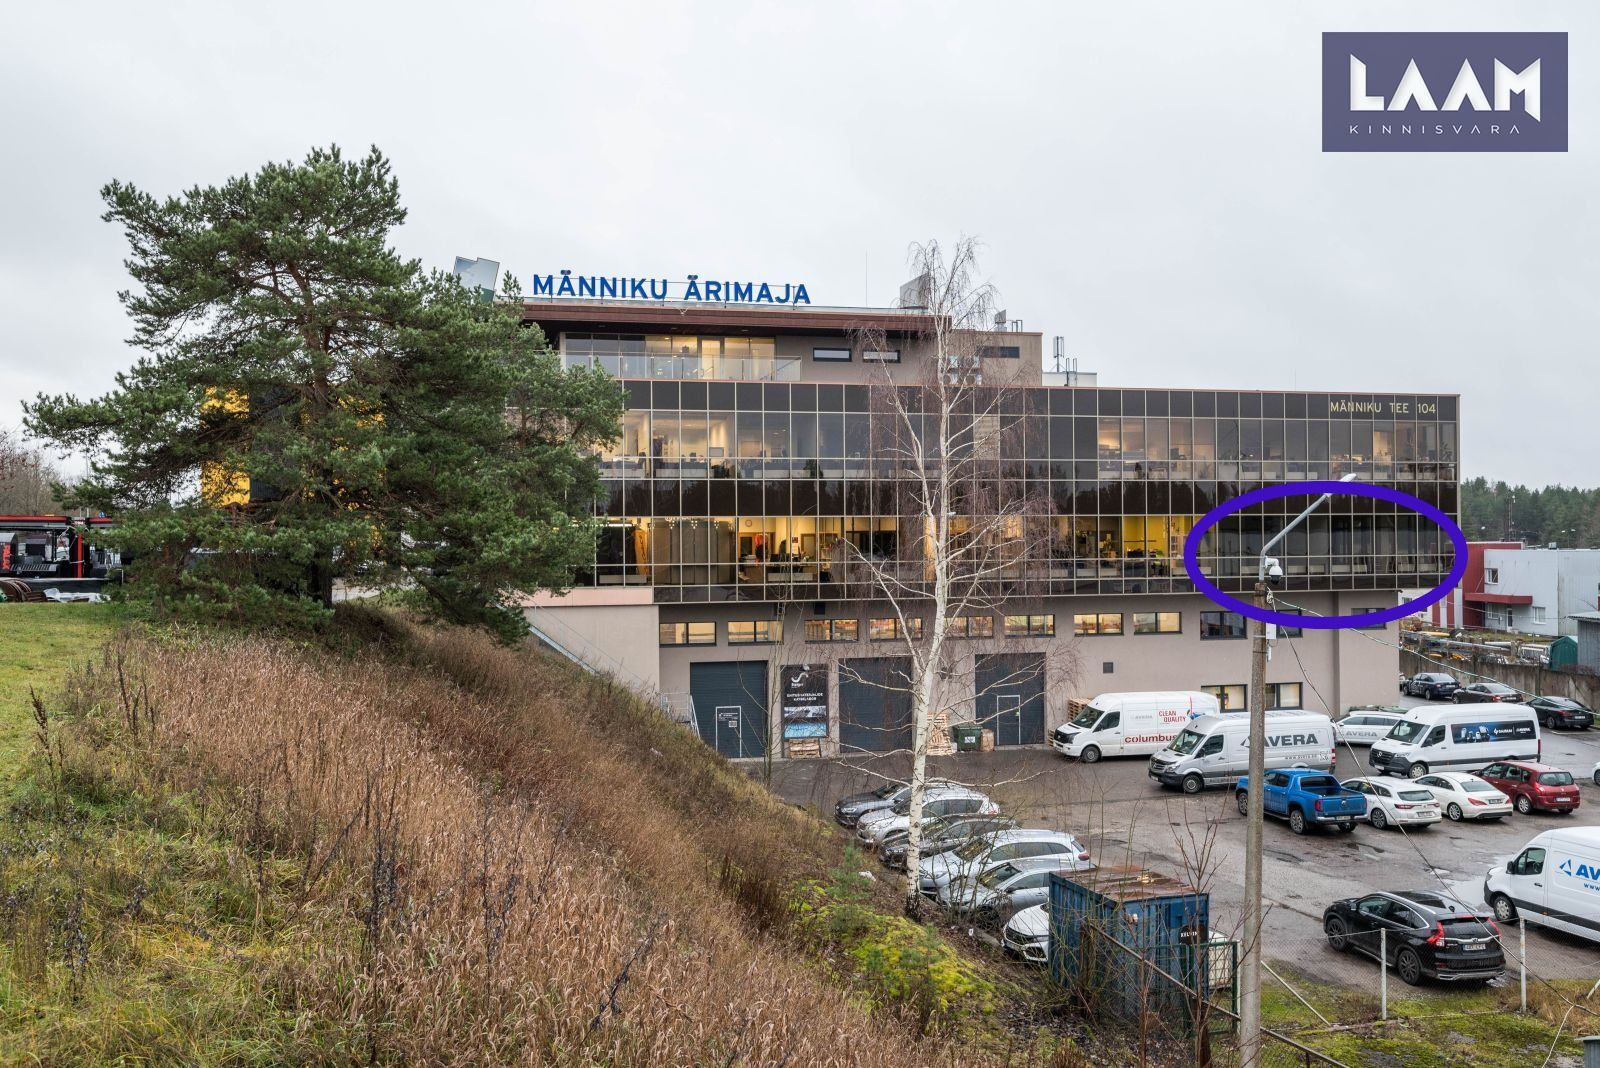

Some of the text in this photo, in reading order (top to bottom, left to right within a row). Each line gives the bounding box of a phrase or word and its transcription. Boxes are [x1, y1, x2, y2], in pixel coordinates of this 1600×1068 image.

[533, 269, 811, 304] MÄNNIKU ÄRIMAJA
[1330, 399, 1436, 414] MÄNNIKU TEE 104
[1124, 733, 1177, 744] columbus
